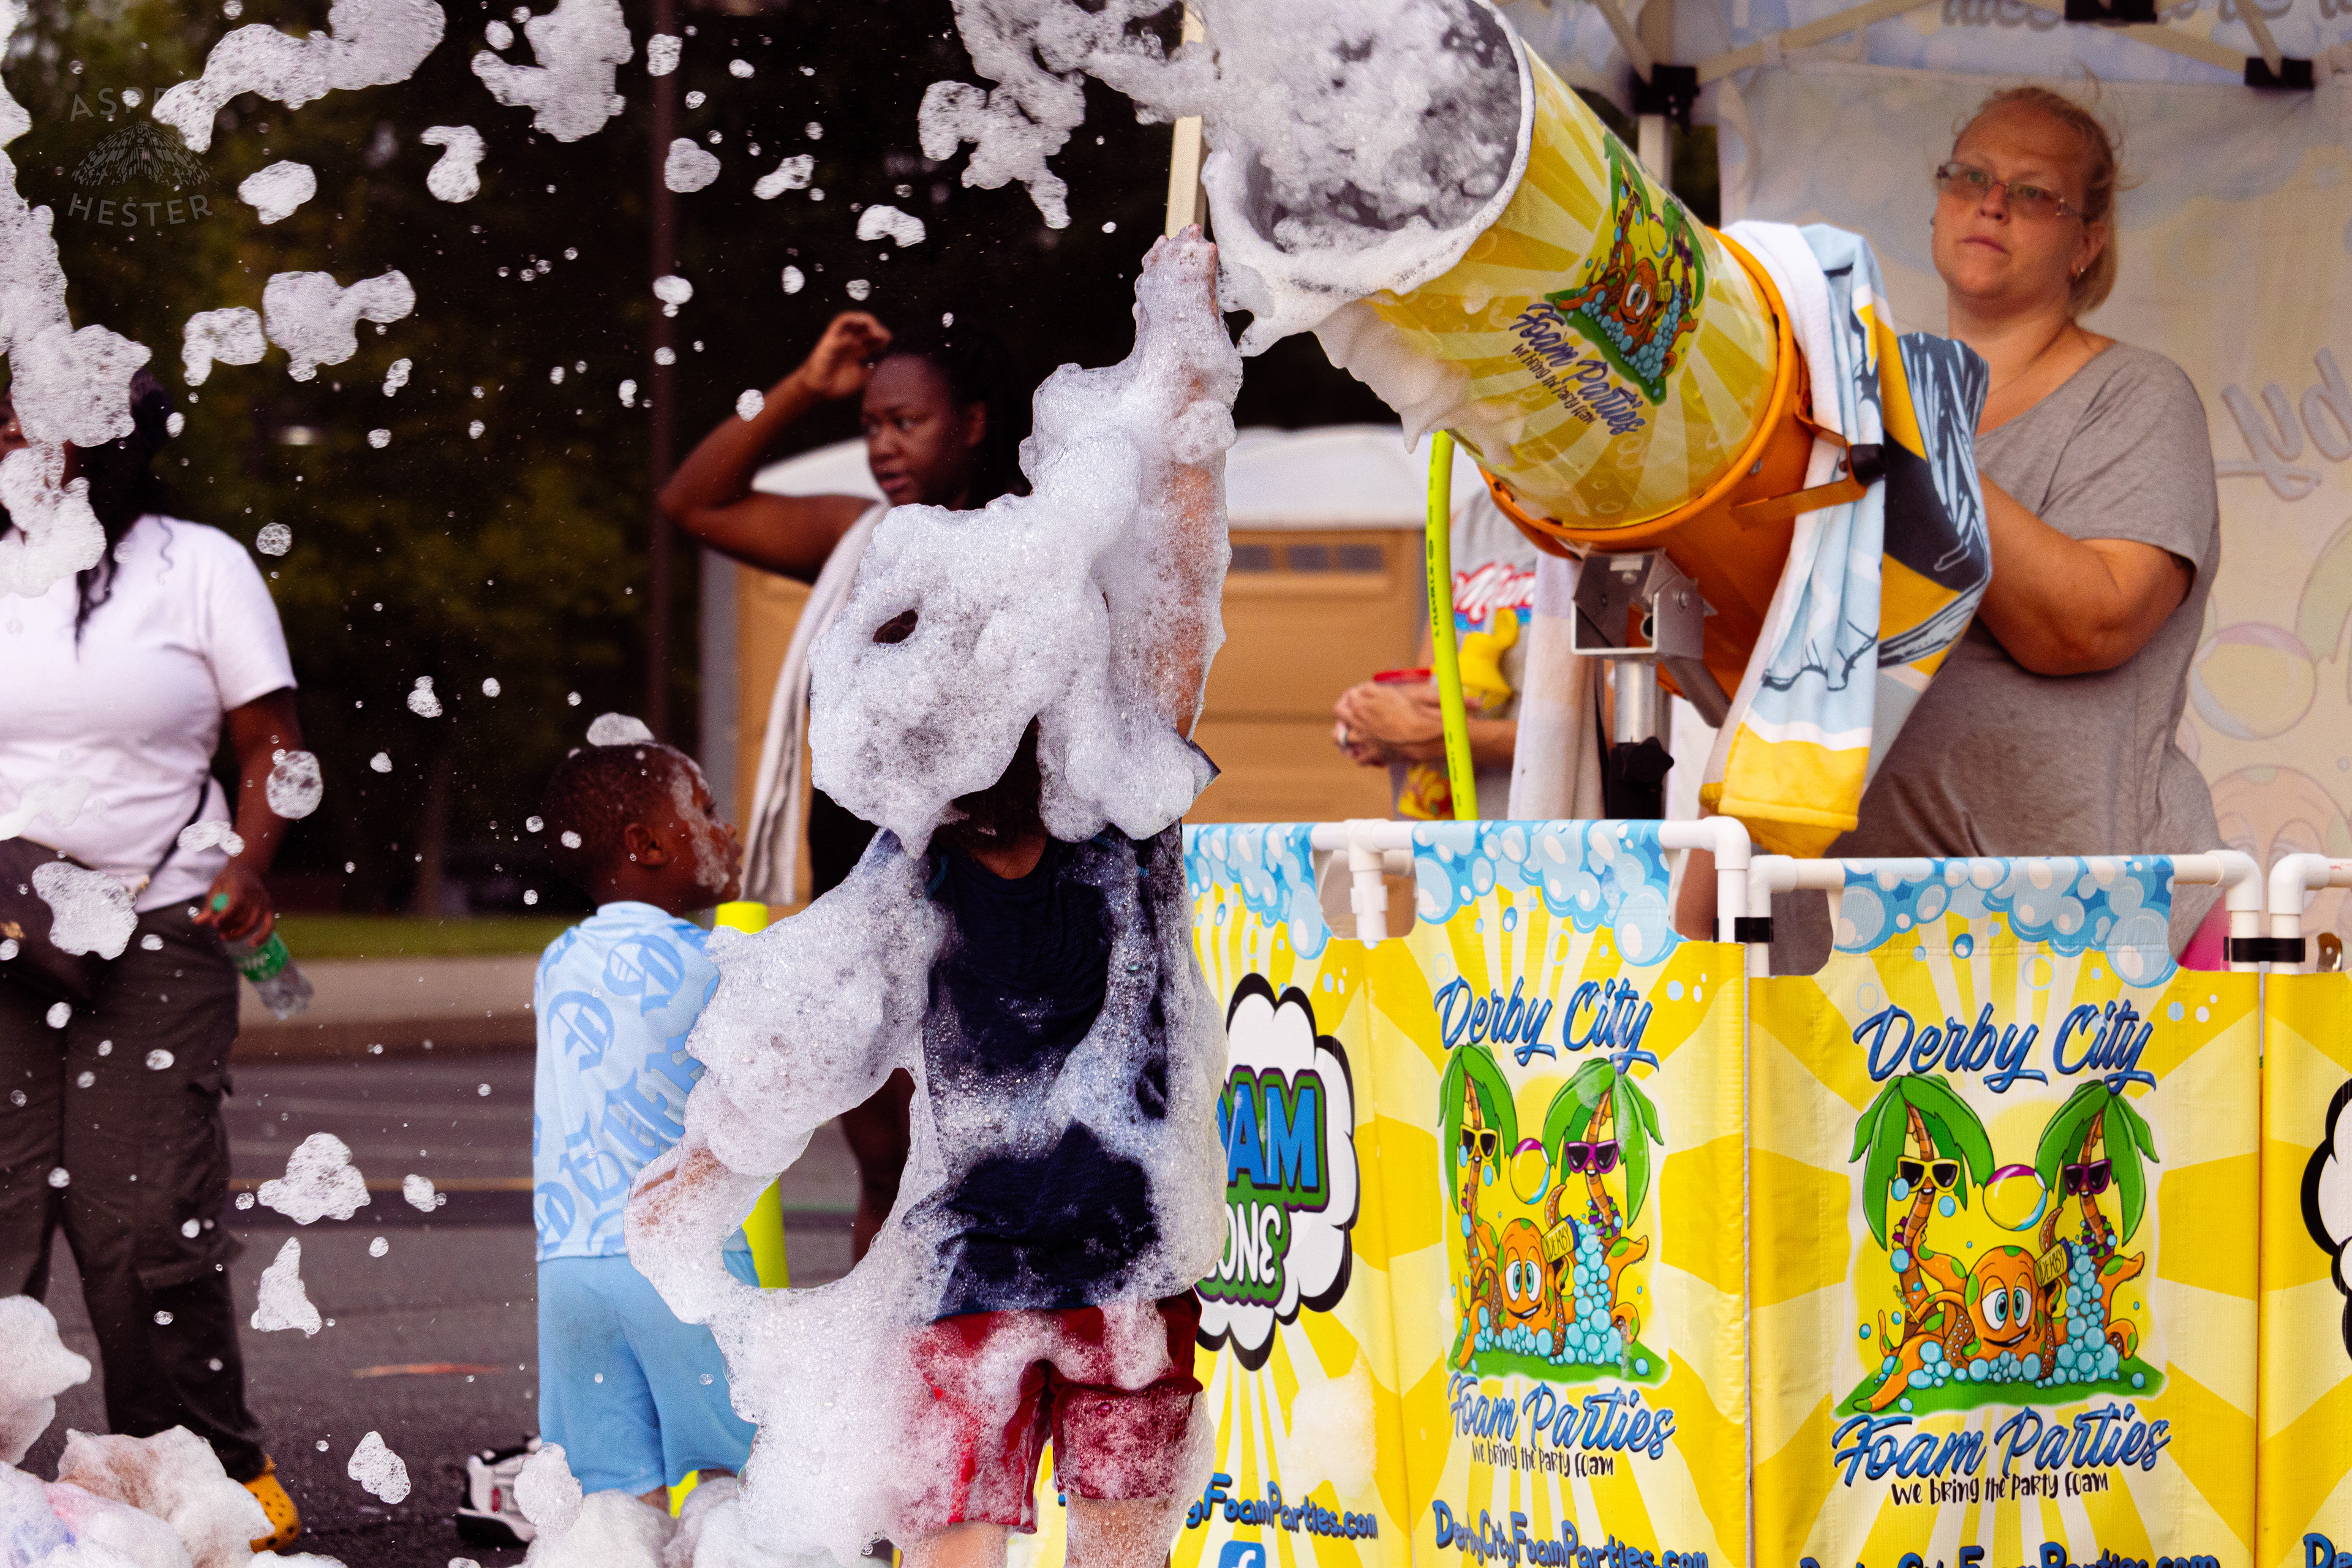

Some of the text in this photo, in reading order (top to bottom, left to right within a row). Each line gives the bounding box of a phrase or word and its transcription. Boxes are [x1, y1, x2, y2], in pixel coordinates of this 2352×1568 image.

[1509, 303, 1646, 435] Foam Parties
[1434, 975, 1659, 1075] Derby City
[1852, 999, 2156, 1095] Derby City
[1217, 1082, 1320, 1193] AM
[1204, 1200, 1281, 1286] ONE
[1545, 1223, 1571, 1259] DERBY
[2039, 1246, 2065, 1283] DERBY
[1447, 1371, 1676, 1460] Foam Parties
[1831, 1402, 2172, 1487] Foam Parties
[1985, 1477, 2006, 1502] the
